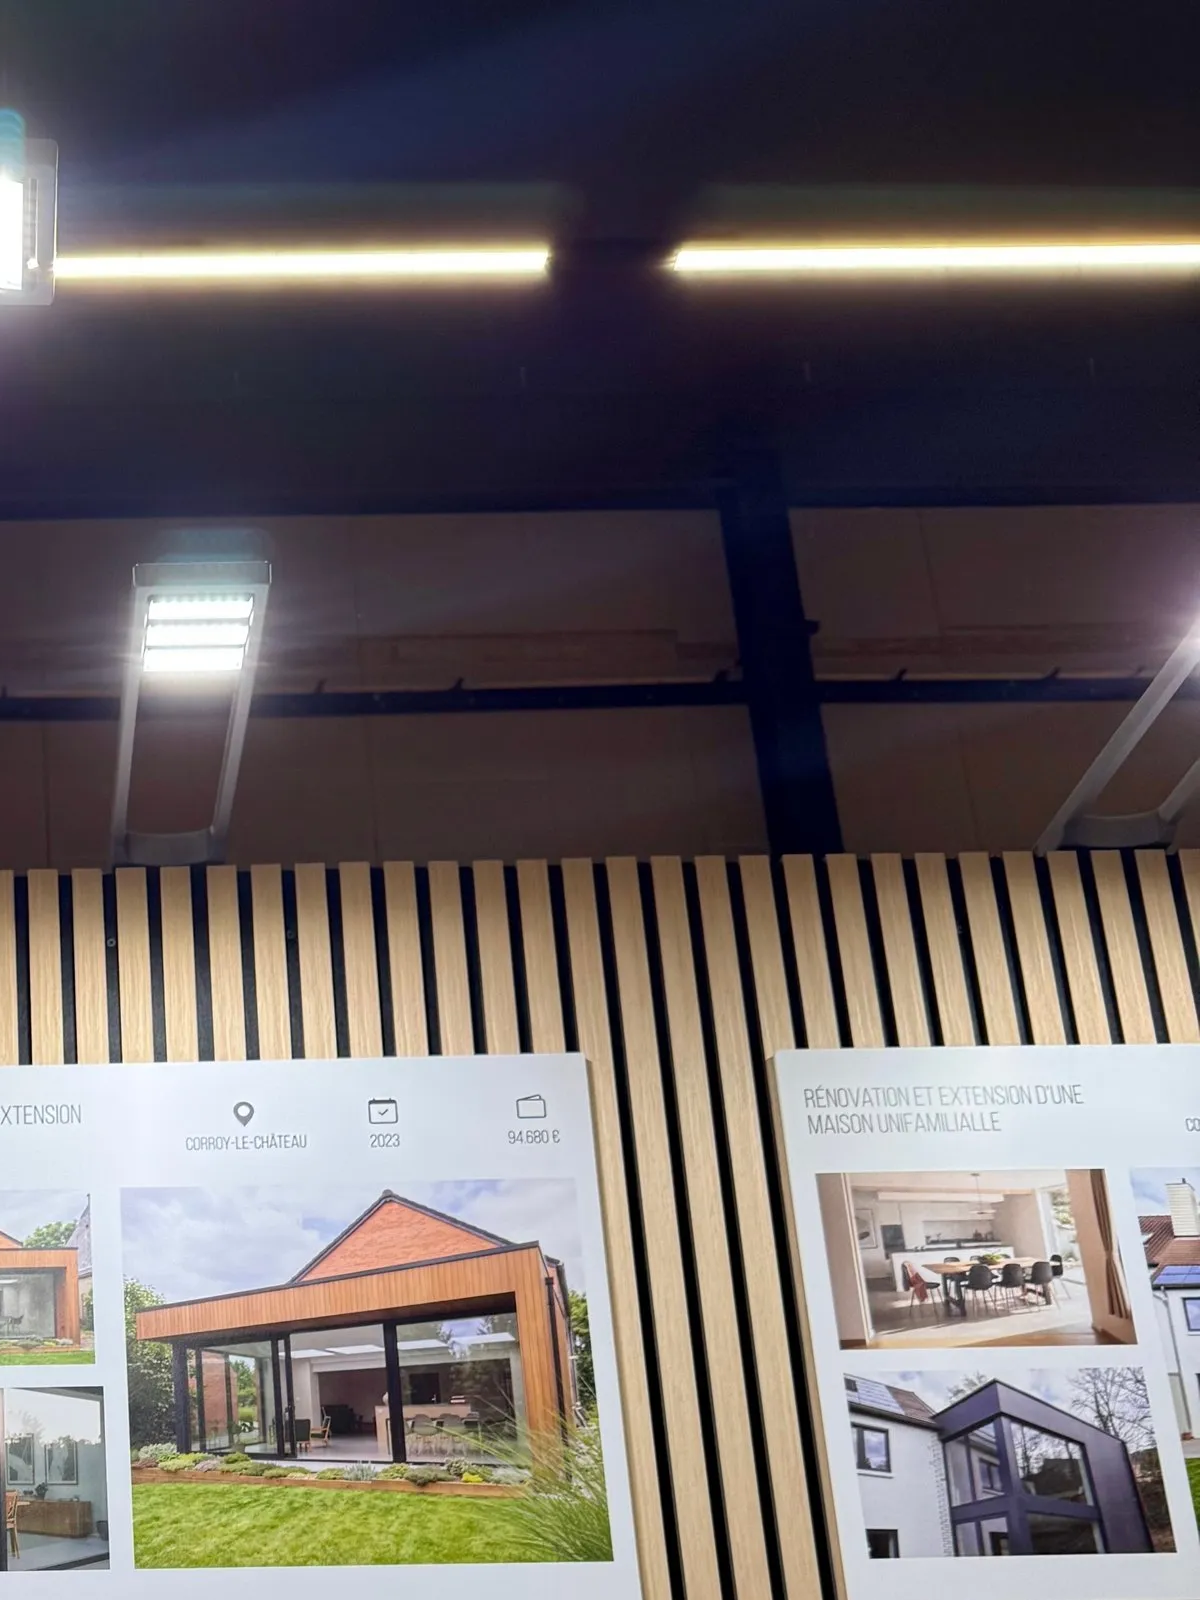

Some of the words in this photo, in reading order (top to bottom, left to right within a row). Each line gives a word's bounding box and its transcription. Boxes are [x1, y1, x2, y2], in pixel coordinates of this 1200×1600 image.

[803, 1084, 910, 1109] RÉNOVATION
[912, 1086, 934, 1107] ET
[938, 1084, 1033, 1107] EXTENSION
[1035, 1083, 1085, 1105] D'UNE
[807, 1113, 874, 1135] MAISON
[876, 1110, 1002, 1134] UNIFAMILIALLE
[185, 1133, 308, 1151] CORROY-LE-CHÂTEAU
[369, 1133, 401, 1148] 2023
[507, 1129, 549, 1145] 94.680
[551, 1129, 561, 1144] €
